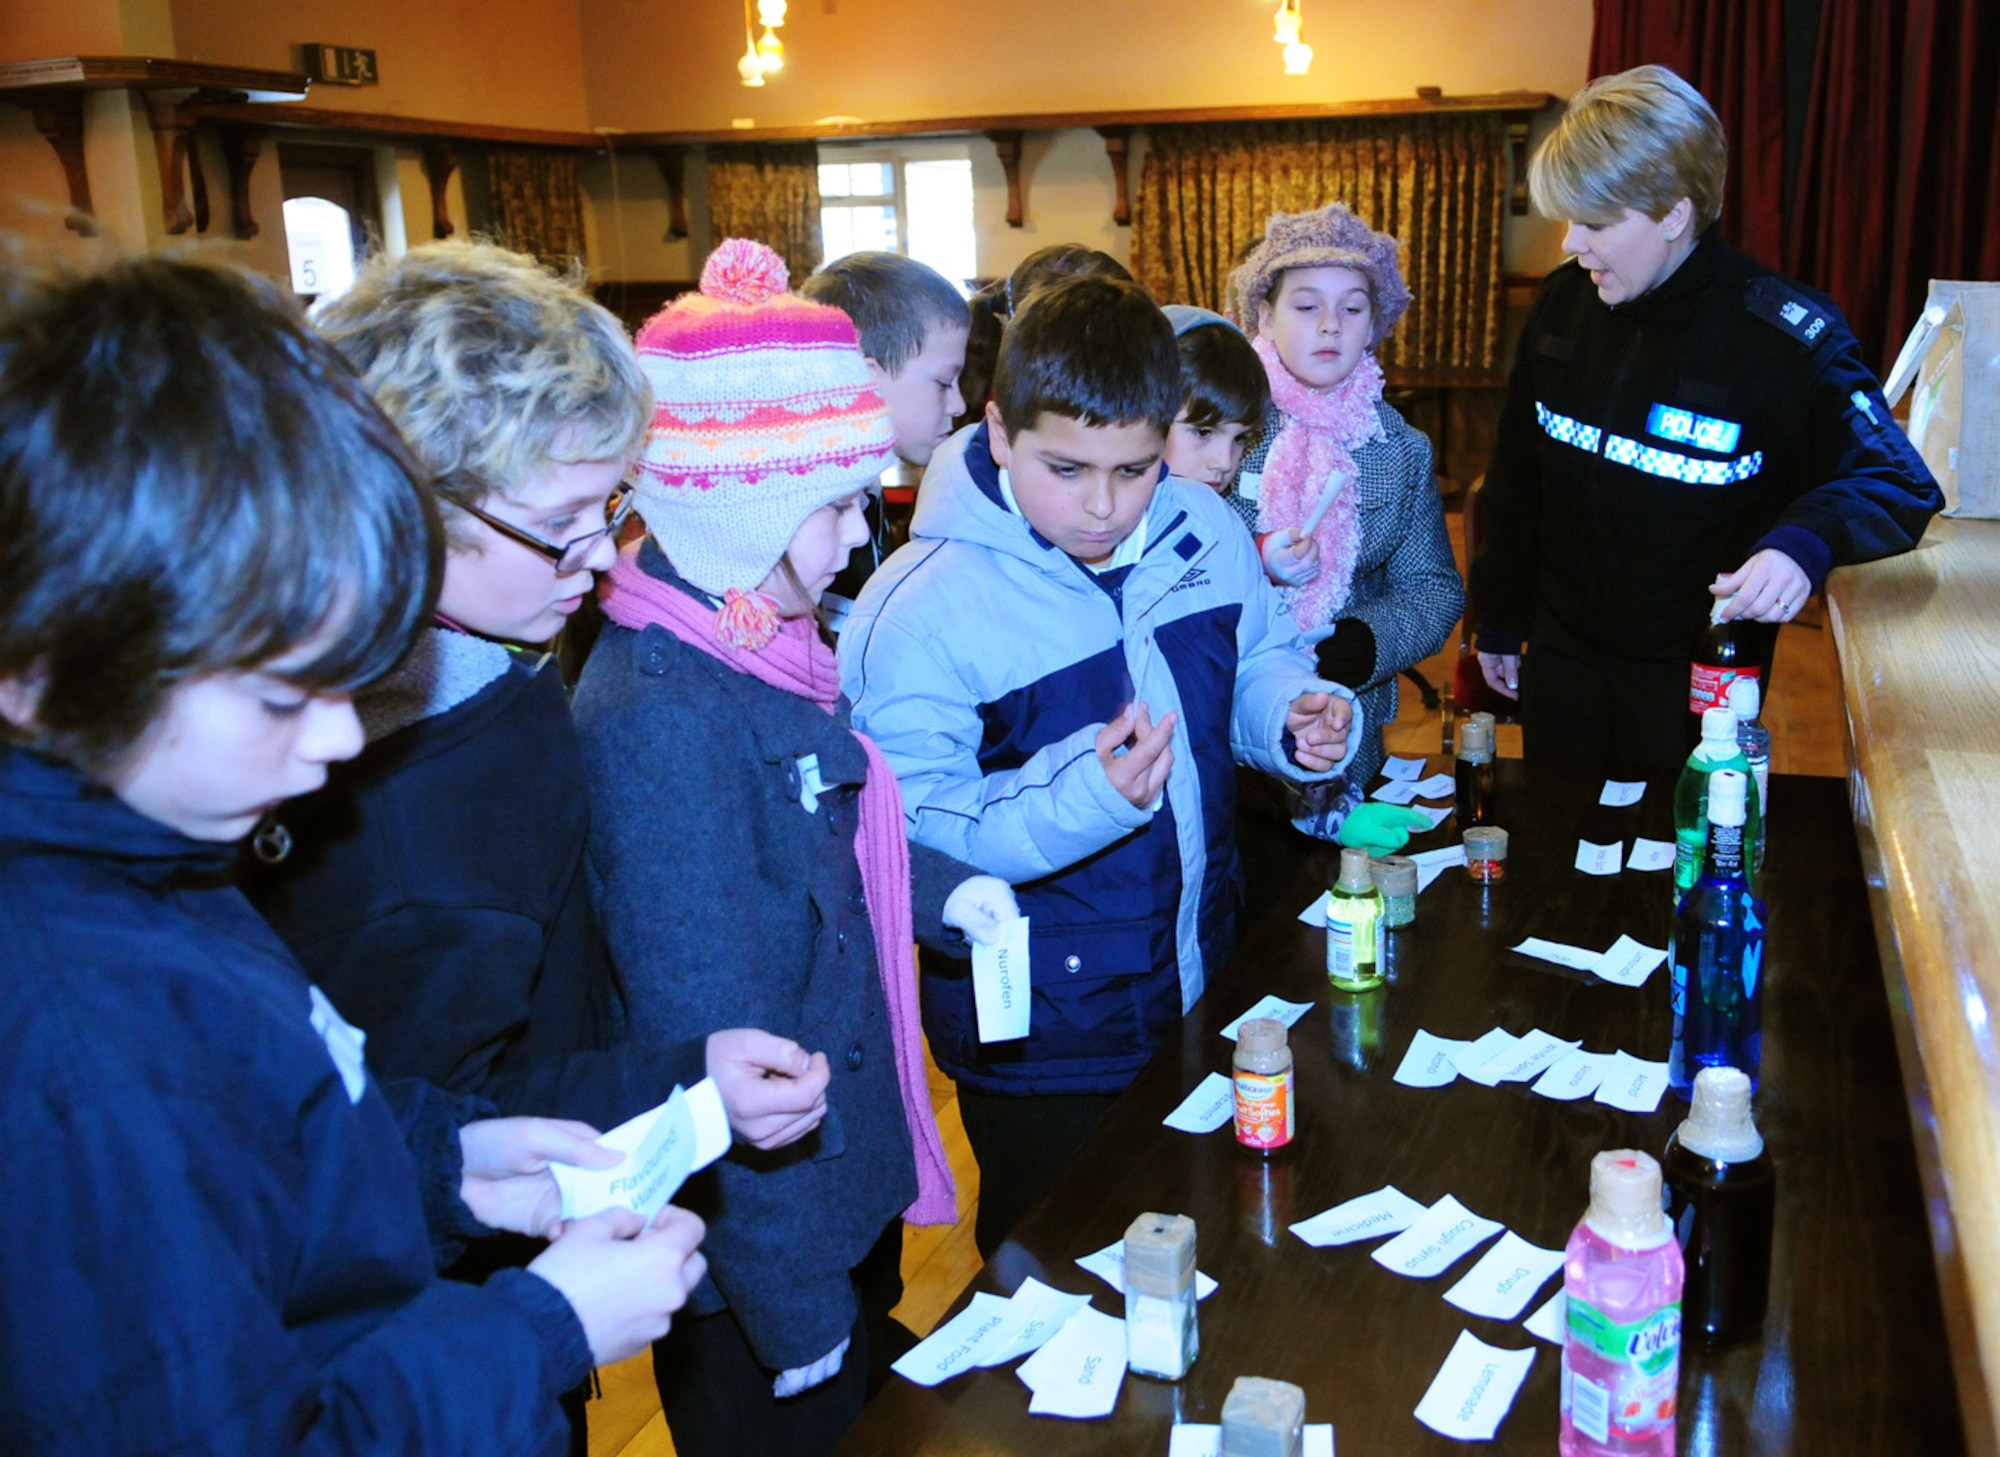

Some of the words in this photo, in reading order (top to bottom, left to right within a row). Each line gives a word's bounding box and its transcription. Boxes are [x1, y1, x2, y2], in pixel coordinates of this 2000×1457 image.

[302, 259, 318, 288] 5
[1804, 317, 1826, 340] 309
[1659, 411, 1724, 444] POLICE
[1171, 578, 1212, 593] UMBRO
[997, 947, 1013, 1010] Nurofen
[609, 1126, 677, 1196] Flavoured
[630, 1164, 671, 1211] Water
[1331, 1210, 1394, 1238] Medicine
[1440, 1218, 1475, 1246] Cough
[1405, 1243, 1442, 1269] Syrup
[1496, 1267, 1531, 1295] Drugs
[971, 1315, 1003, 1344] Plant
[936, 1344, 971, 1372] Food
[1078, 1354, 1102, 1386] Sand
[1456, 1361, 1502, 1423] Lemonade
